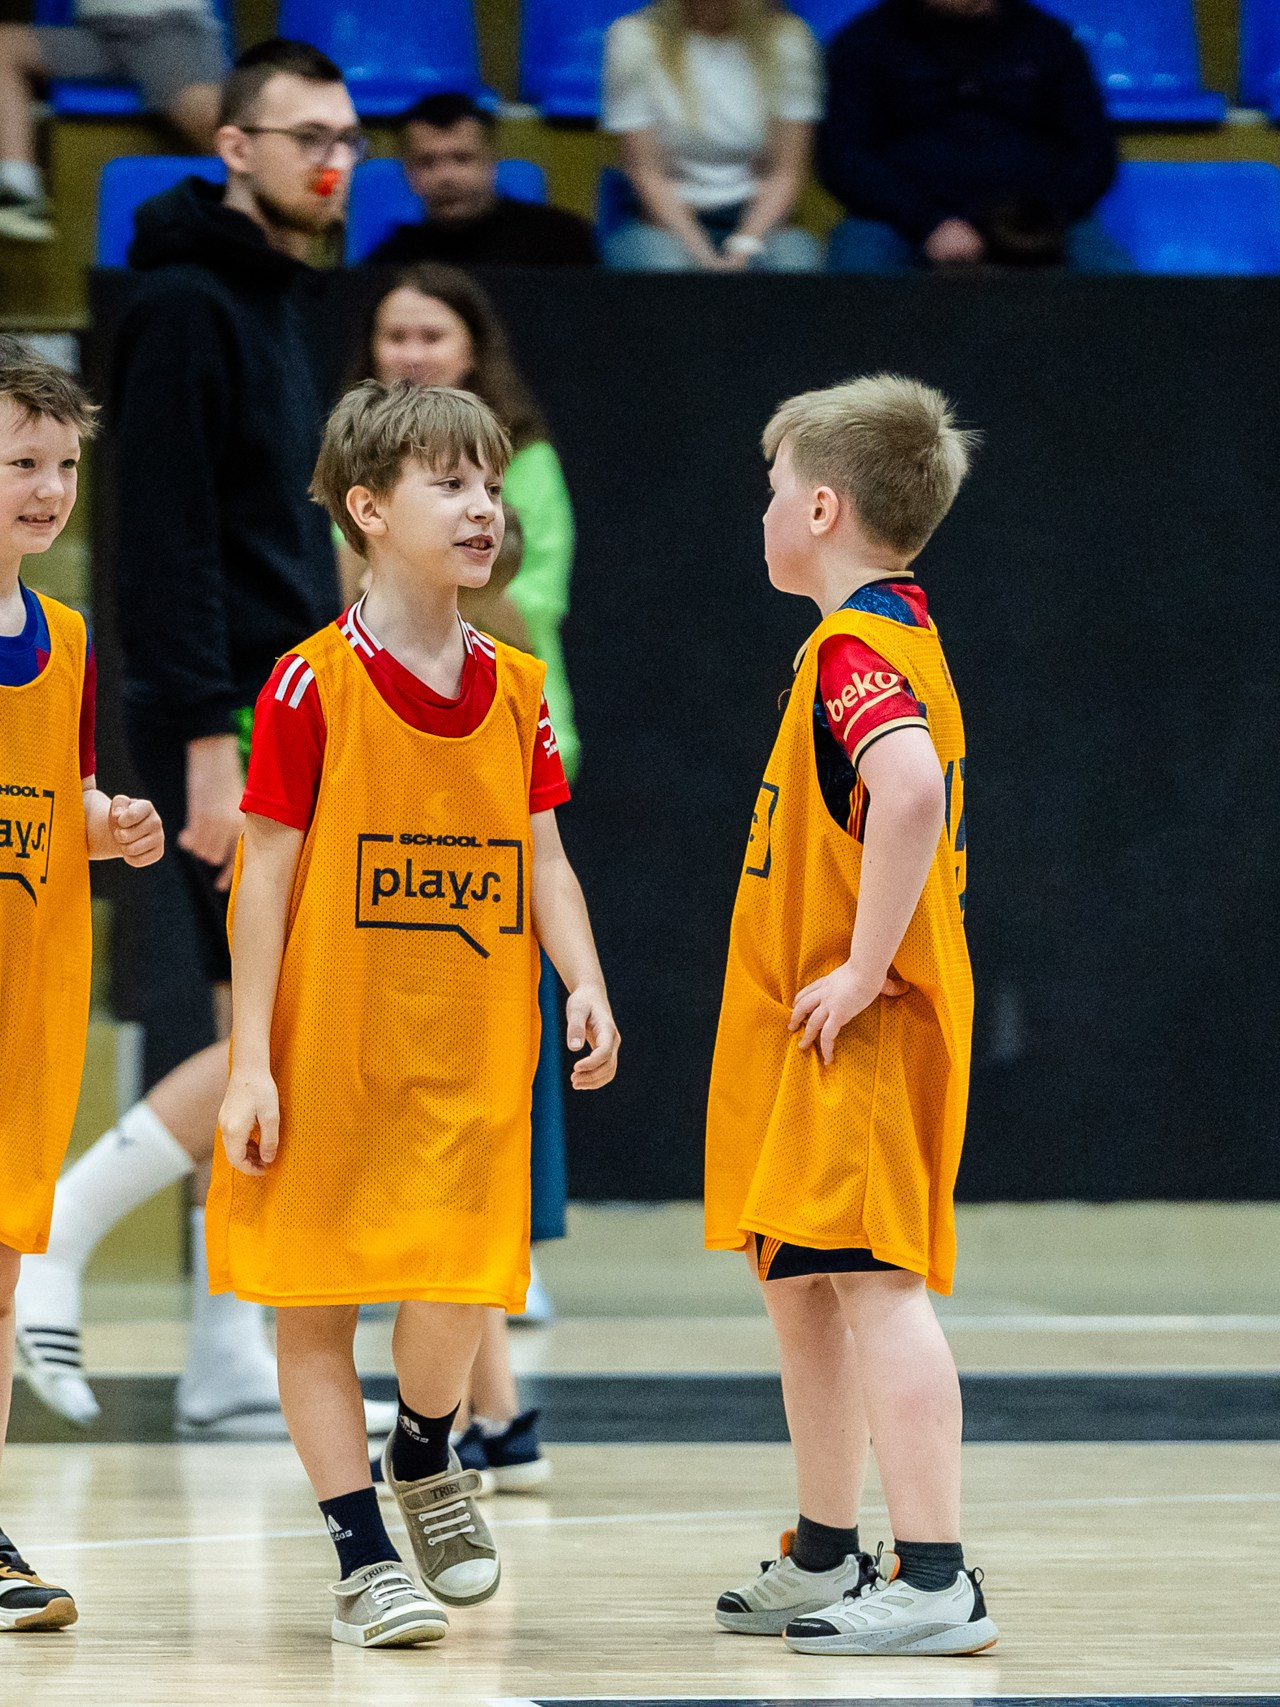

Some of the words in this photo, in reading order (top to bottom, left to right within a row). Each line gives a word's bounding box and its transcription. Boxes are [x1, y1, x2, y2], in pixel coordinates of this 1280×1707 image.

[826, 671, 898, 722] beko
[399, 833, 482, 847] SCHOOL
[371, 858, 501, 909] plays.
